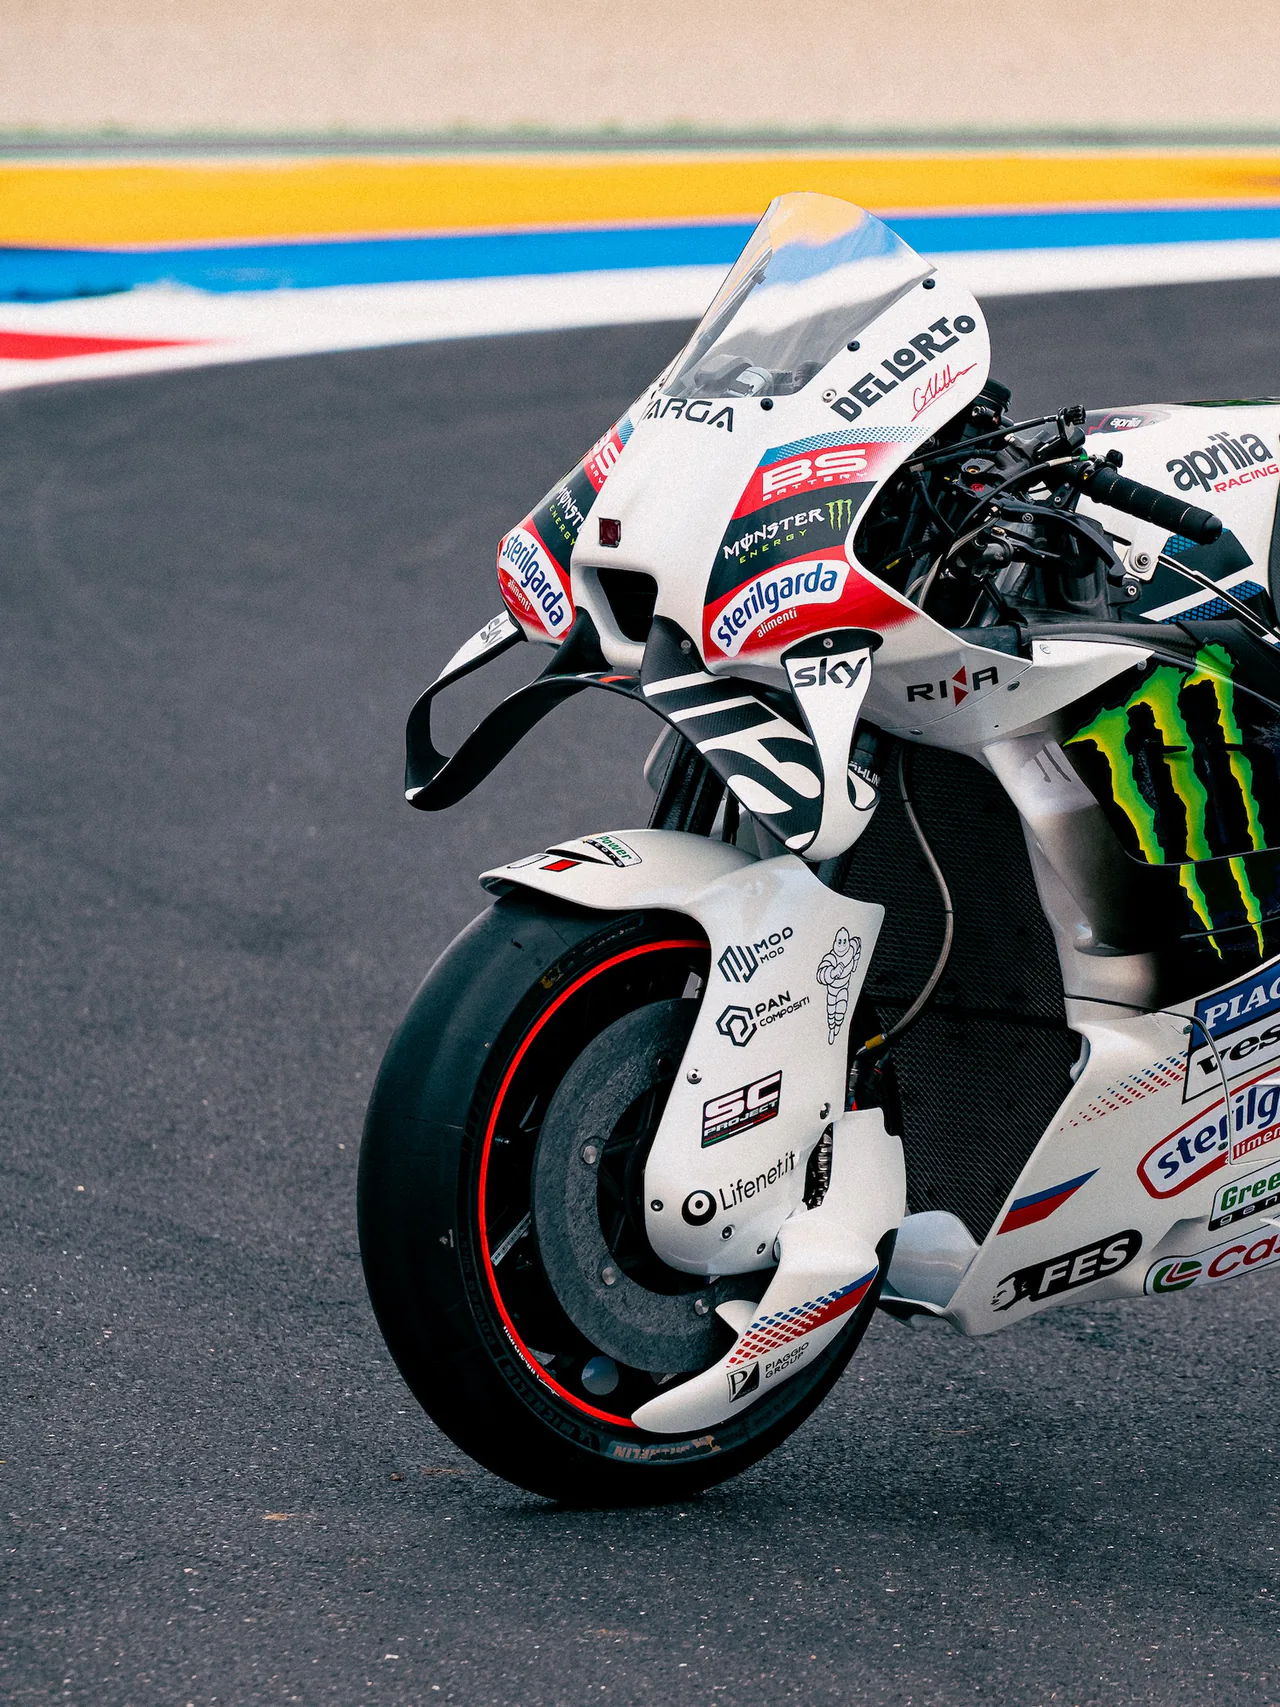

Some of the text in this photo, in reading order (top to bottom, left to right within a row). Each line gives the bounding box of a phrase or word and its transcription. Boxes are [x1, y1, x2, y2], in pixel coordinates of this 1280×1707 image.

[830, 315, 976, 422] DELLORTO
[1109, 416, 1143, 428] aprilia
[762, 449, 868, 494] BS
[1166, 431, 1274, 493] aprilia
[1214, 463, 1280, 493] RACING
[762, 471, 868, 501] BATTERY
[739, 529, 807, 564] ENERGY
[502, 533, 565, 627] sterilgarda
[507, 578, 532, 612] alimenti
[717, 562, 838, 648] sterilgarda
[756, 607, 798, 638] alimenti
[794, 657, 868, 689] sky
[753, 926, 793, 954] MOD
[759, 946, 784, 964] MOD
[755, 990, 791, 1017] PAN
[760, 996, 810, 1027] COMPOSITI
[704, 1073, 780, 1129] SC
[704, 1099, 778, 1136] PROJECT
[718, 1151, 796, 1211] Lifenet.it
[1038, 1238, 1130, 1294] FES
[765, 1341, 810, 1373] PIAGGIO
[765, 1351, 805, 1379] GROUP
